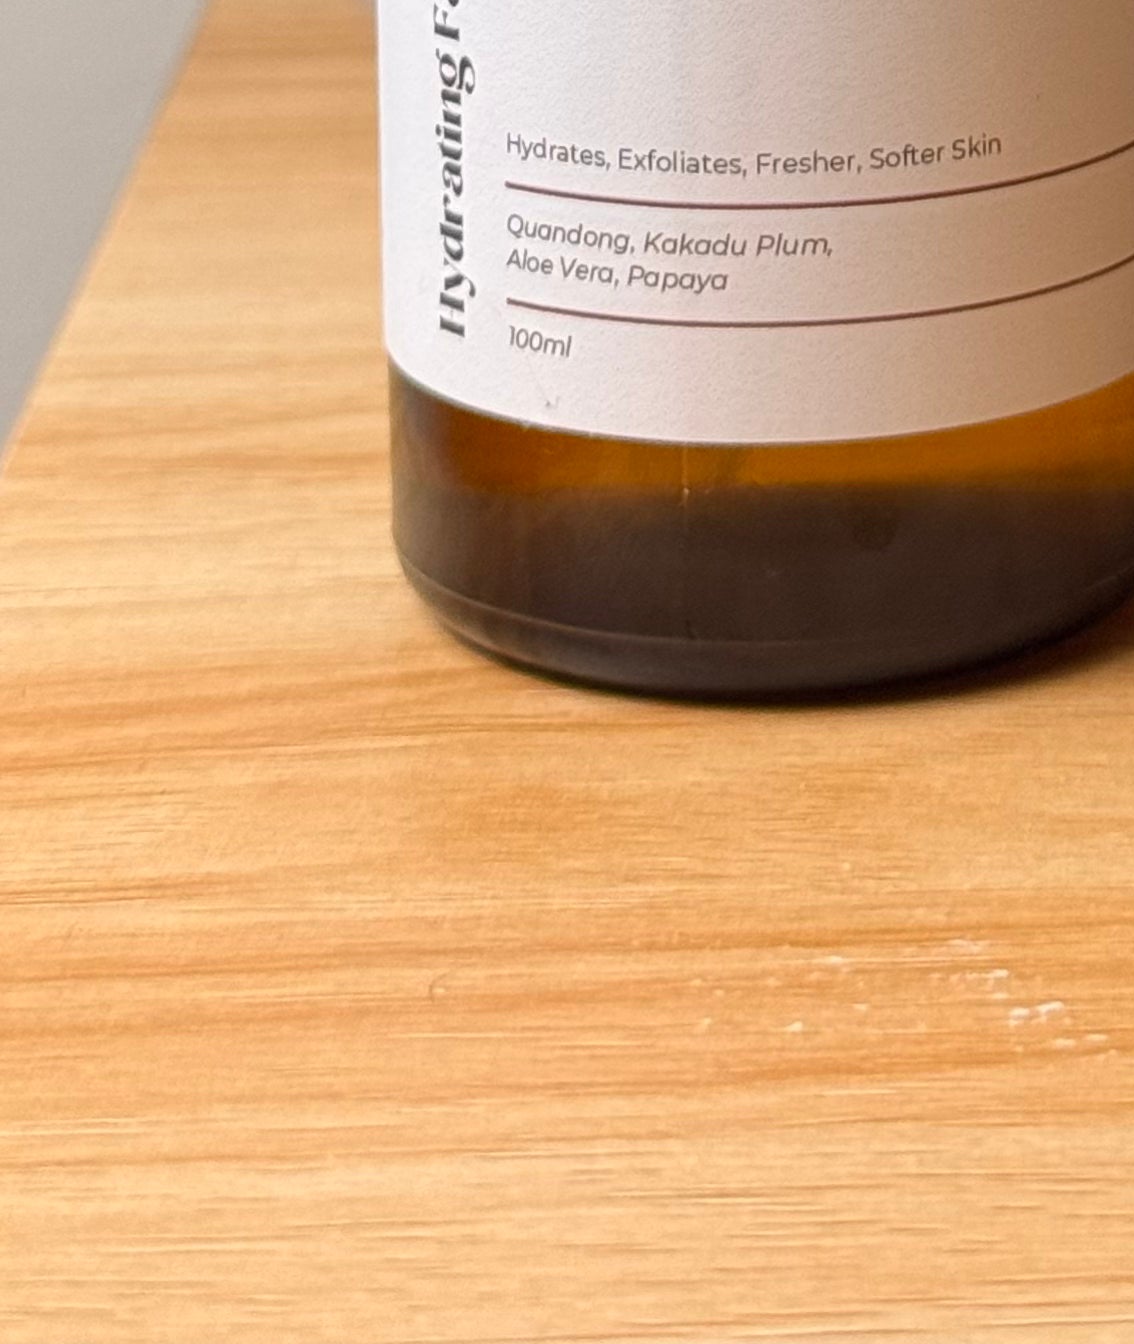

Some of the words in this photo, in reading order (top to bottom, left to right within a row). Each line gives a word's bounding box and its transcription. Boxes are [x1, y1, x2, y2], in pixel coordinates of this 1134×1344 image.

[507, 132, 611, 171] Hydrates,
[619, 148, 747, 178] Exfoliates,
[757, 150, 862, 175] Fresher,
[870, 144, 944, 169] Softer
[952, 133, 1001, 160] Skin
[434, 47, 476, 338] Hydrating
[507, 214, 635, 255] Quandong,
[644, 231, 747, 257] Kakadu
[756, 233, 832, 257] Plum,
[506, 249, 553, 275] Aloe
[559, 257, 620, 289] Vera,
[627, 265, 728, 295] Papaya
[509, 325, 572, 357] 100ml
